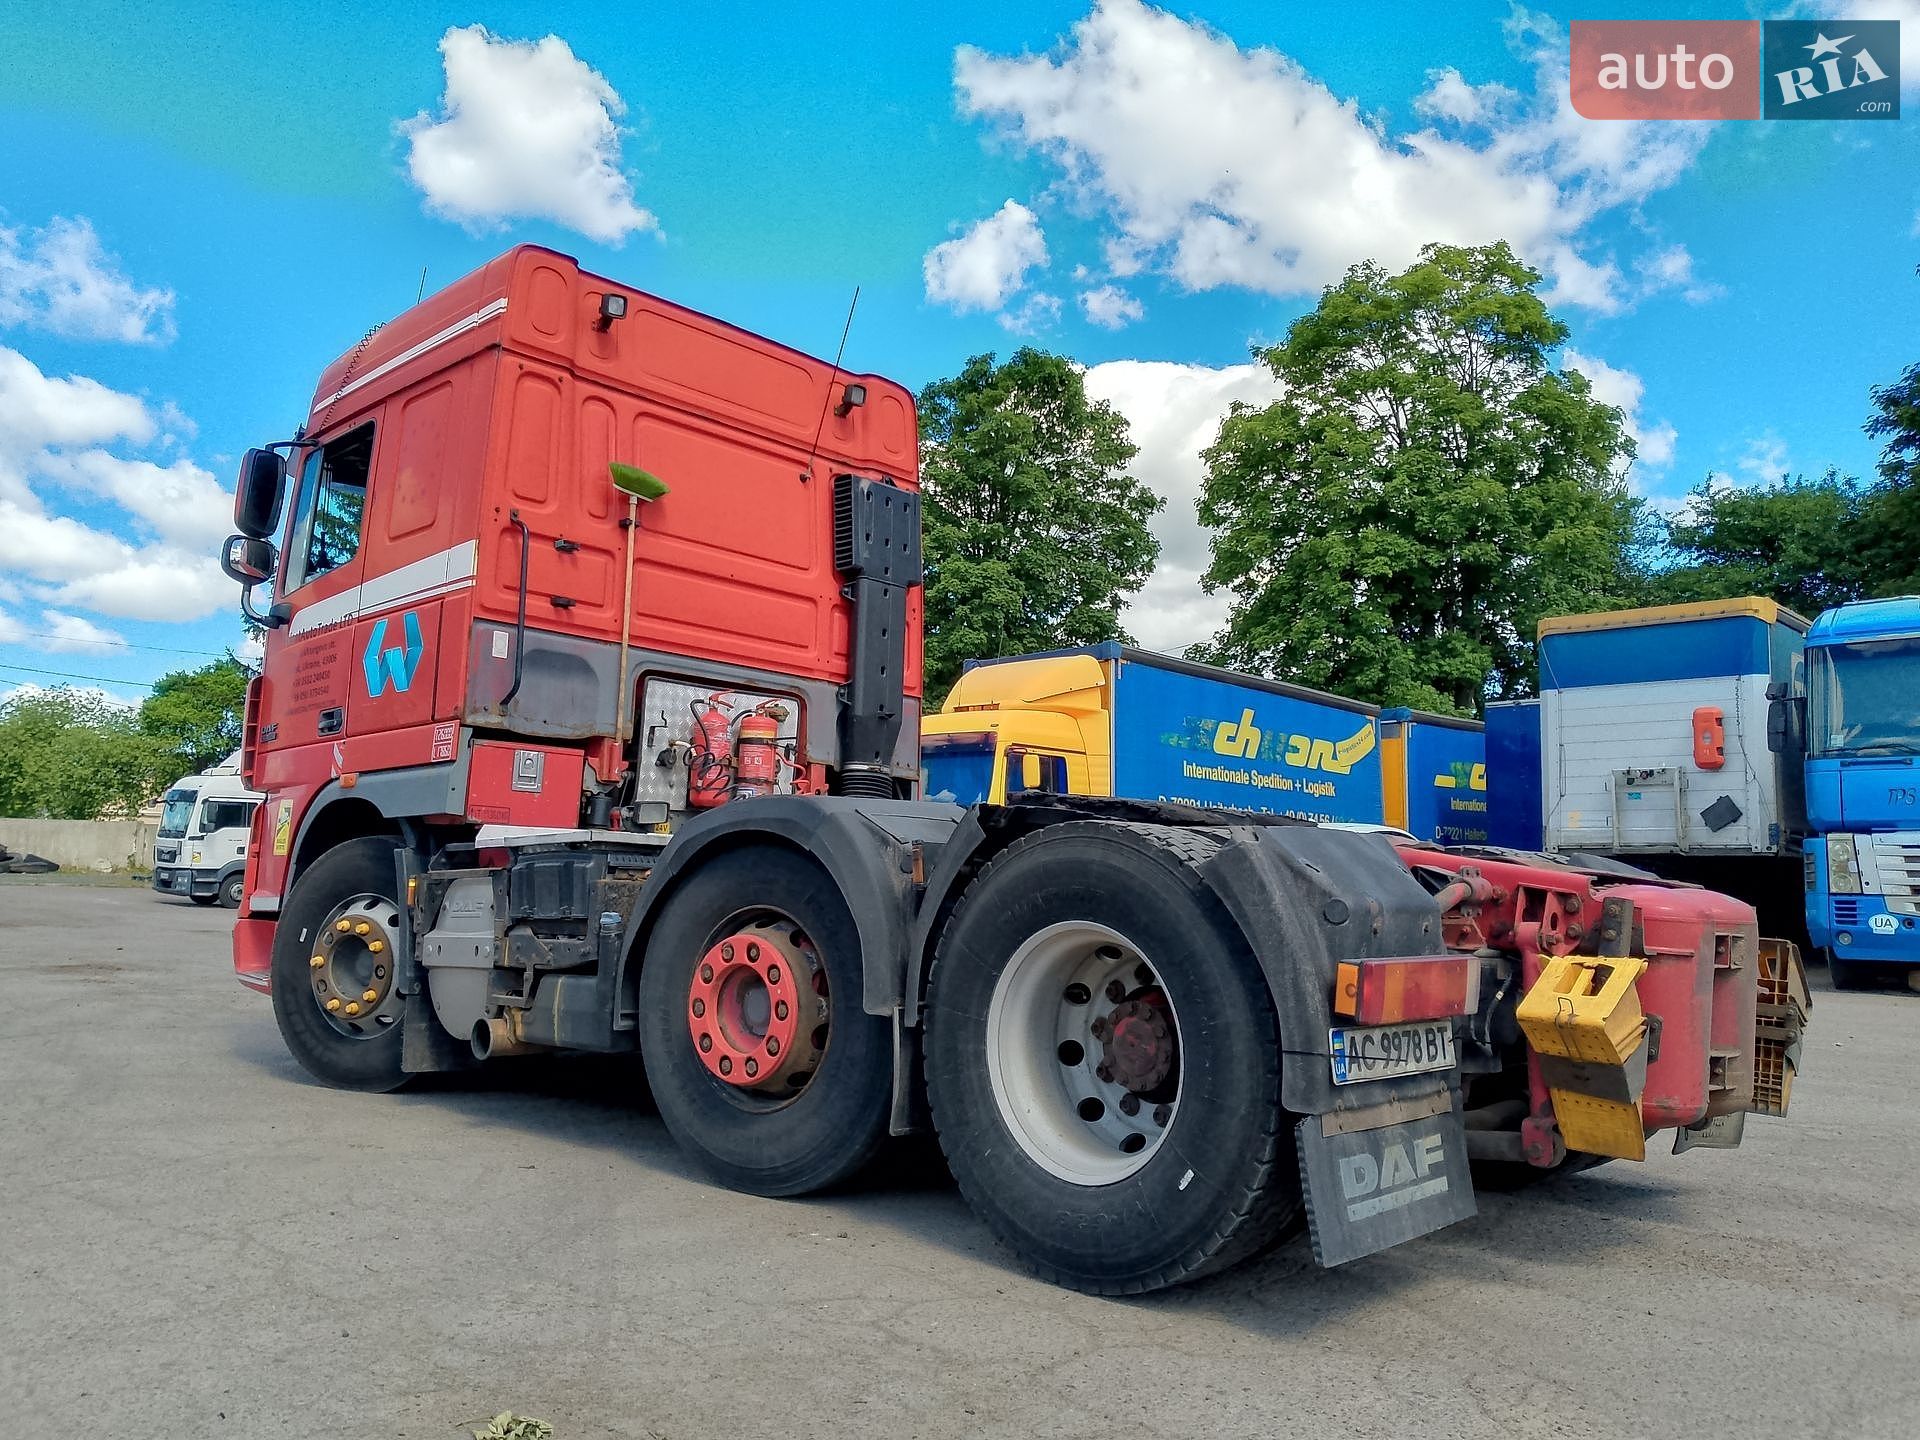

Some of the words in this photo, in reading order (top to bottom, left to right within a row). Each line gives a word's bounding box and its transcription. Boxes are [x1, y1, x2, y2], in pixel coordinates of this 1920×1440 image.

[1183, 760, 1250, 785] Internationale
[1251, 770, 1293, 791] Spedition
[1303, 778, 1336, 797] Logistik
[1875, 917, 1893, 928] UA
[1348, 1035, 1376, 1074] AC
[1381, 1029, 1423, 1069] 9978
[1425, 1026, 1447, 1062] BT
[1335, 1063, 1346, 1075] UA
[1339, 1133, 1444, 1200] DAF
